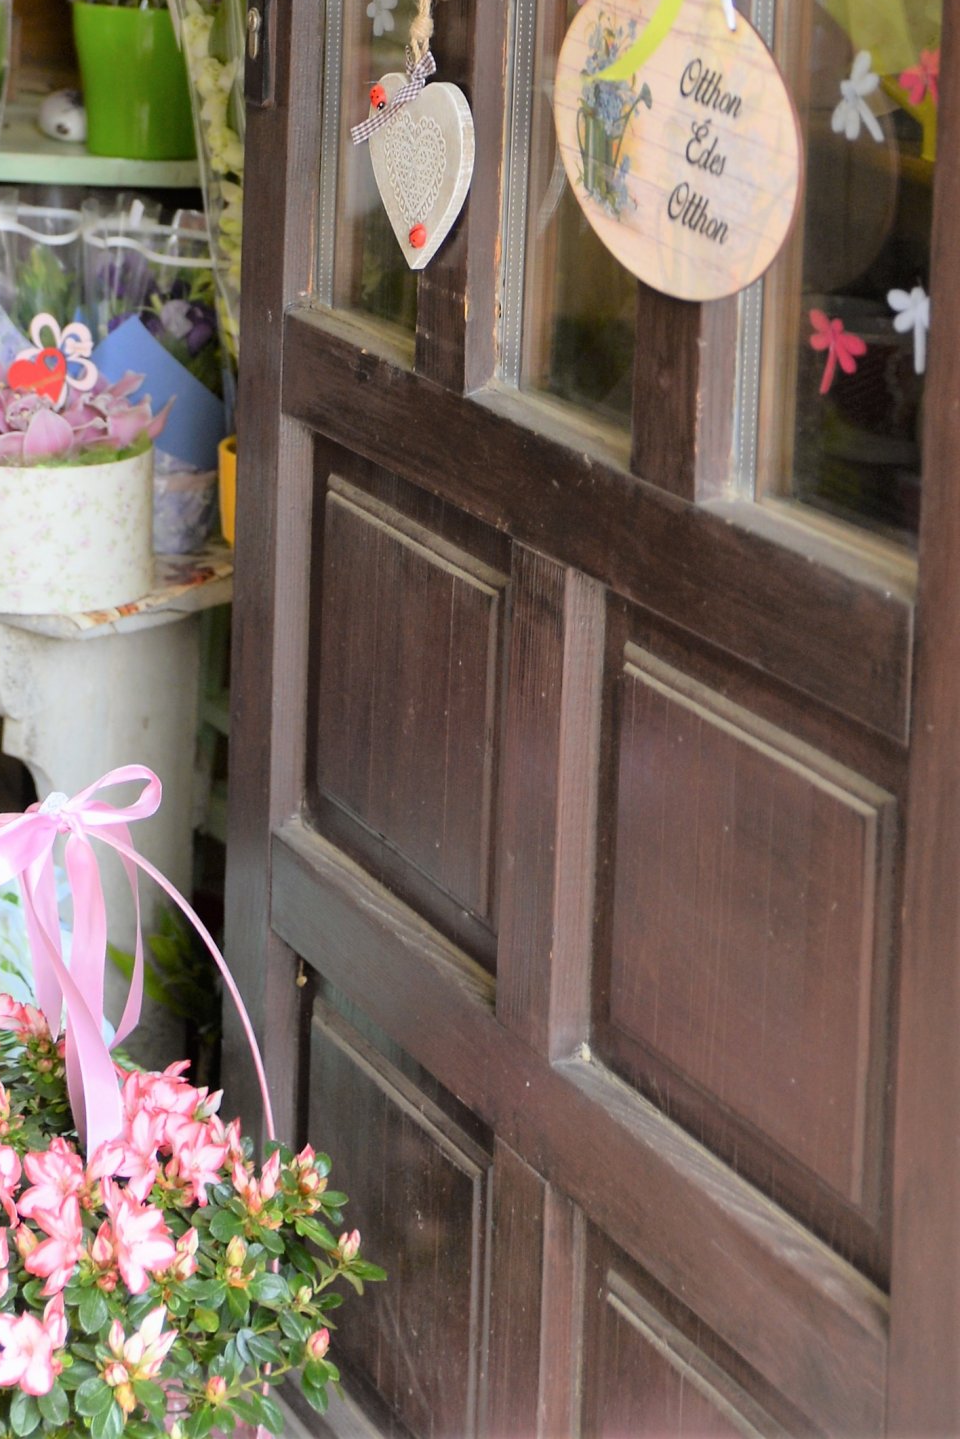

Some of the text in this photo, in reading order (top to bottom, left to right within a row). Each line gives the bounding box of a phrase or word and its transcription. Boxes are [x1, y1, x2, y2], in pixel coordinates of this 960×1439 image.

[680, 58, 742, 118] Otthon
[685, 118, 726, 177] Édes
[667, 181, 728, 244] Otthon
